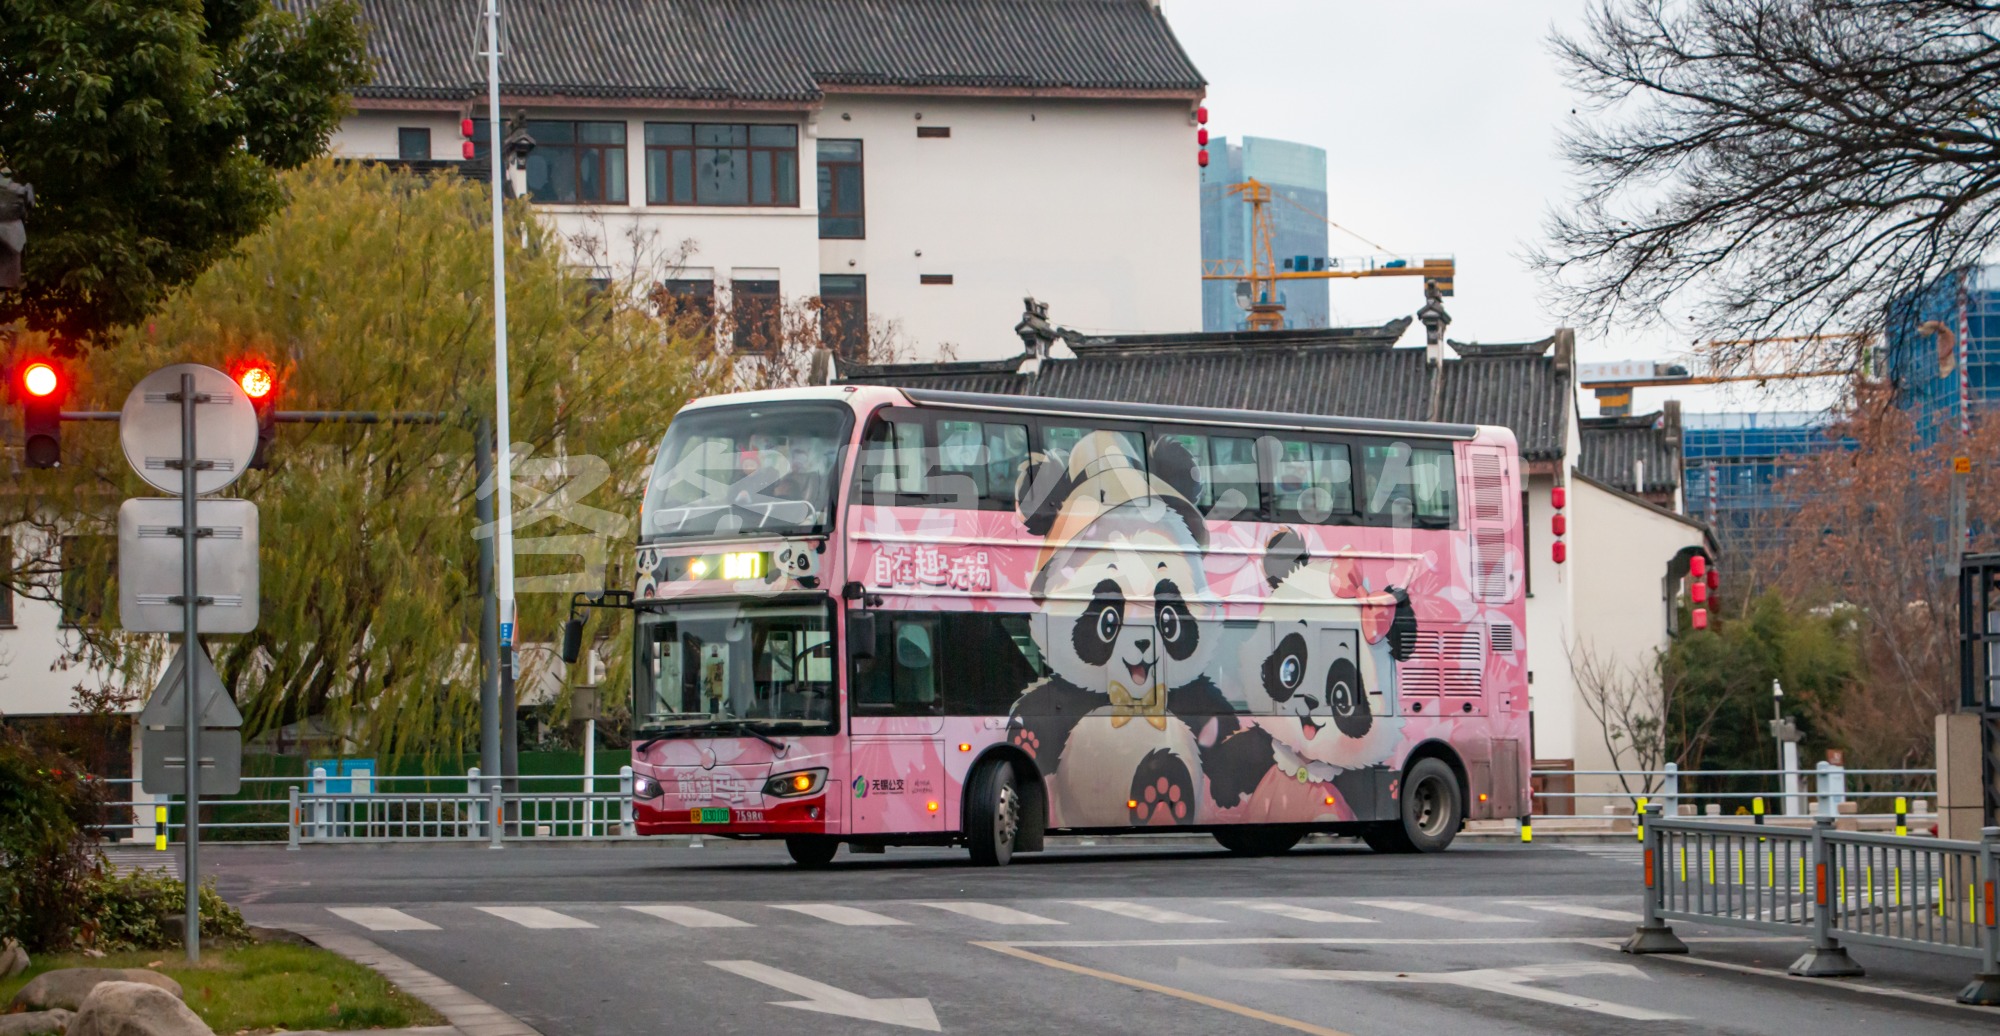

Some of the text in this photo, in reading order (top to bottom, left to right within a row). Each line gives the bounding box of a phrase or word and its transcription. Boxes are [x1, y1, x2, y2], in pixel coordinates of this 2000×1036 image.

[874, 545, 991, 588] 自在趣无锡
[678, 773, 746, 803] 熊猫巴士
[872, 779, 904, 791] 无锡公交
